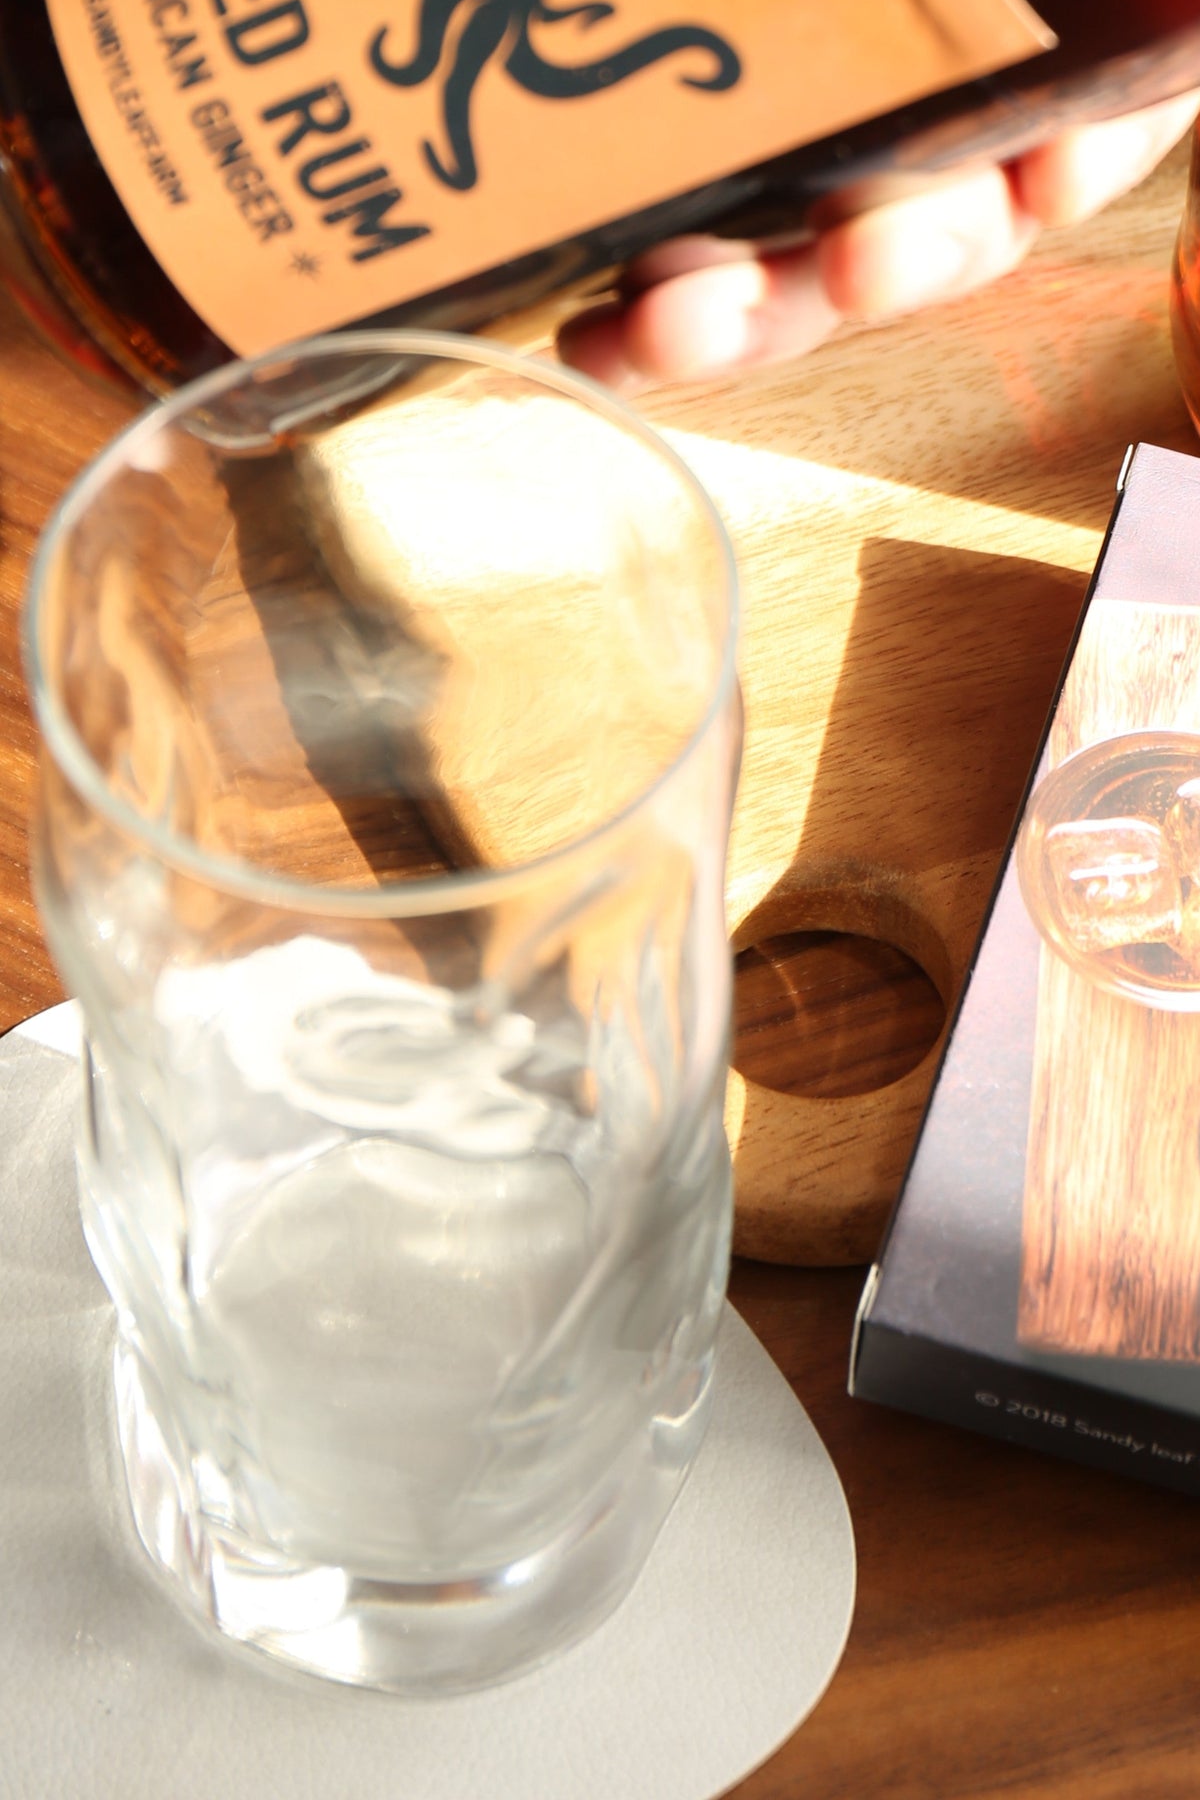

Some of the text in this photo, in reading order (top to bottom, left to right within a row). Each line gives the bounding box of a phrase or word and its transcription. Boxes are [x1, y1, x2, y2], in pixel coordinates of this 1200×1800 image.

[191, 99, 295, 243] GINGER
[261, 76, 433, 263] RUM
[1005, 1401, 1068, 1428] 2018
[1074, 1418, 1146, 1453] Sandy
[1151, 1441, 1194, 1466] leaf
